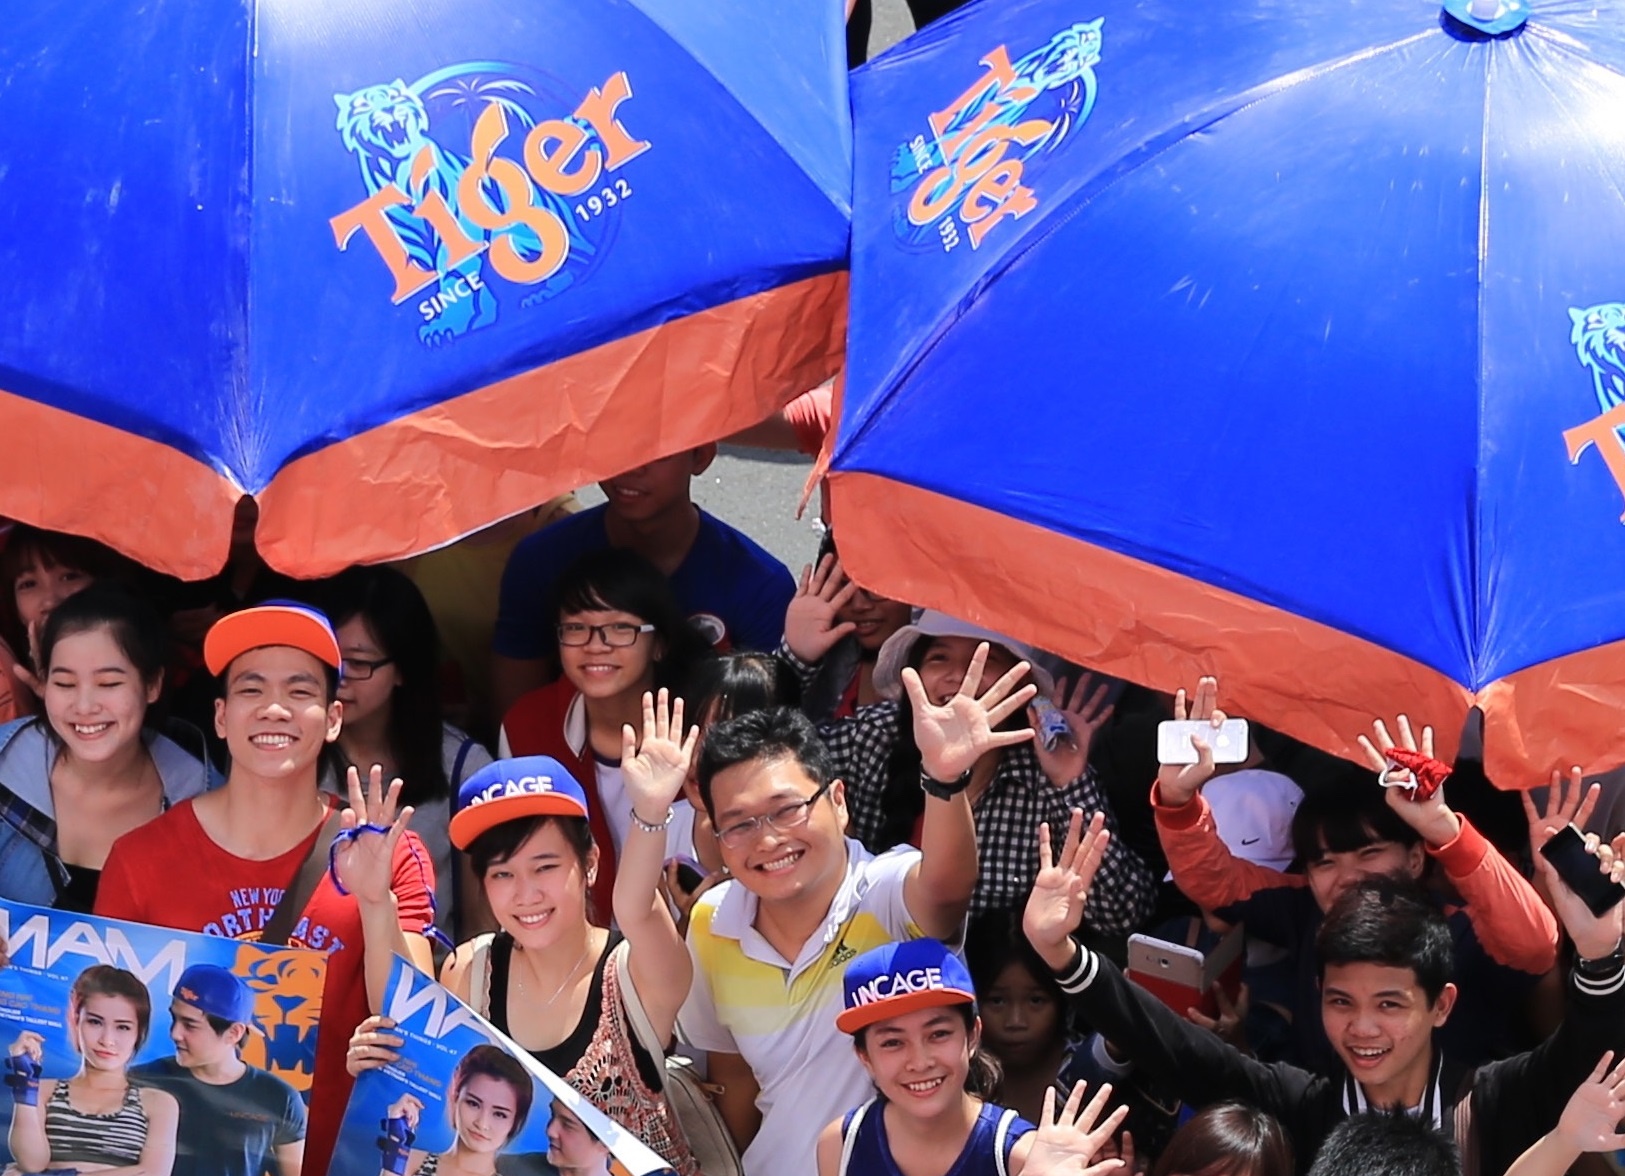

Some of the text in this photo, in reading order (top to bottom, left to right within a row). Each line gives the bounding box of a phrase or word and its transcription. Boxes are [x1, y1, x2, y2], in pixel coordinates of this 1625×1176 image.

[908, 44, 1053, 250] Tiger
[908, 134, 933, 174] SINCE
[329, 71, 652, 305] Tiger
[575, 179, 632, 222] 1932
[938, 215, 960, 252] 1932
[418, 270, 485, 321] SINCE
[229, 887, 260, 908] NEW
